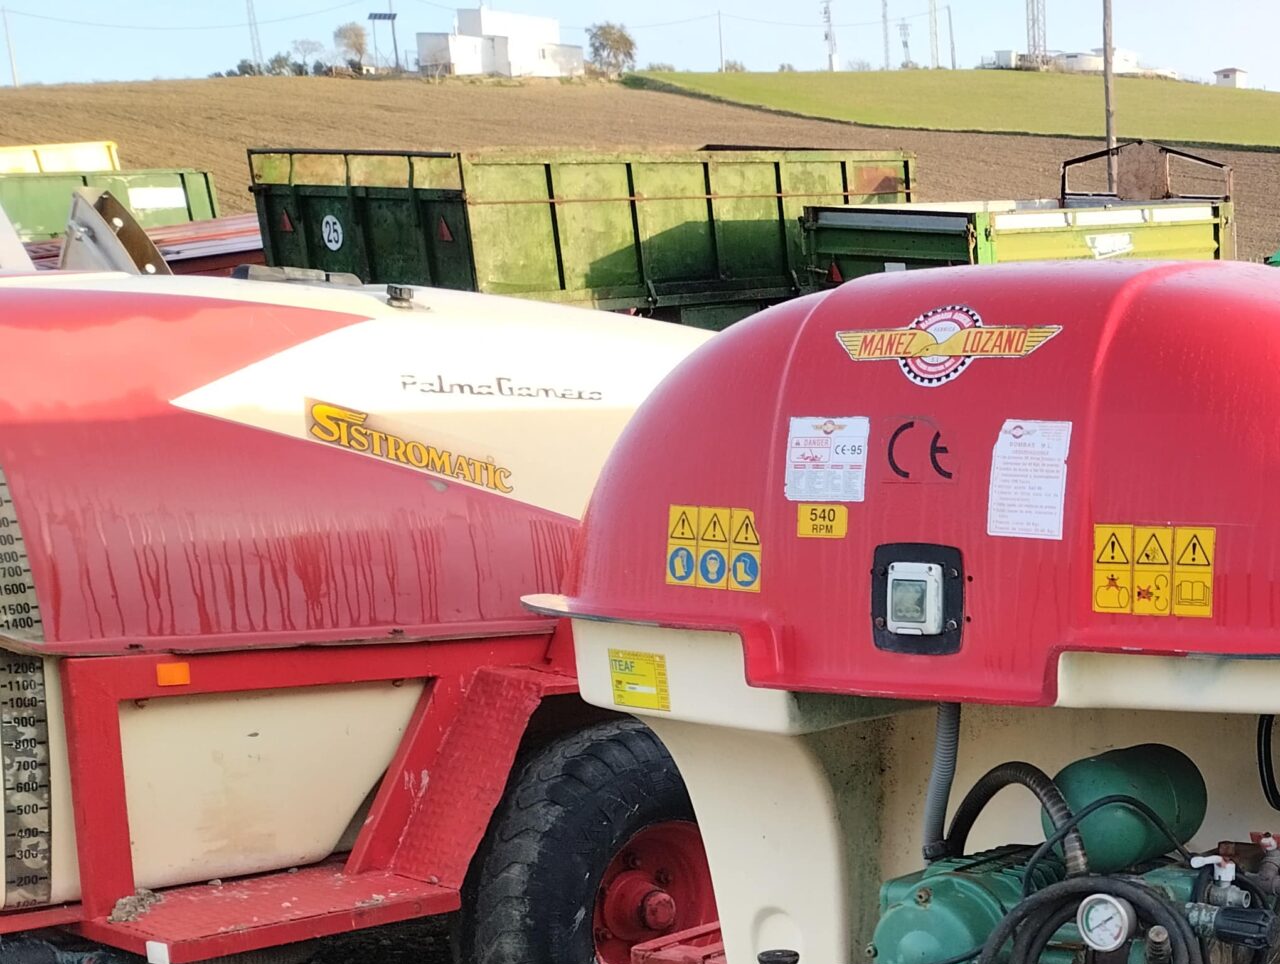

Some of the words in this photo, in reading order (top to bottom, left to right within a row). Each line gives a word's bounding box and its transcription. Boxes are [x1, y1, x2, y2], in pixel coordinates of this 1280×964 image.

[325, 220, 340, 244] 25
[961, 329, 1028, 354] LOZANO
[310, 402, 514, 494] SISTROMATIC
[887, 421, 953, 480] CE
[809, 508, 836, 522] 540
[811, 524, 833, 534] RPM
[2, 602, 30, 616] 1500
[4, 616, 33, 630] 1400
[8, 680, 36, 691] 1100
[9, 697, 37, 708] 1000
[13, 716, 36, 727] 900
[14, 738, 37, 749] 800
[16, 760, 38, 771] 700
[16, 782, 38, 793] 600
[16, 804, 38, 815] 500
[17, 849, 38, 860] 300
[16, 875, 38, 887] 200
